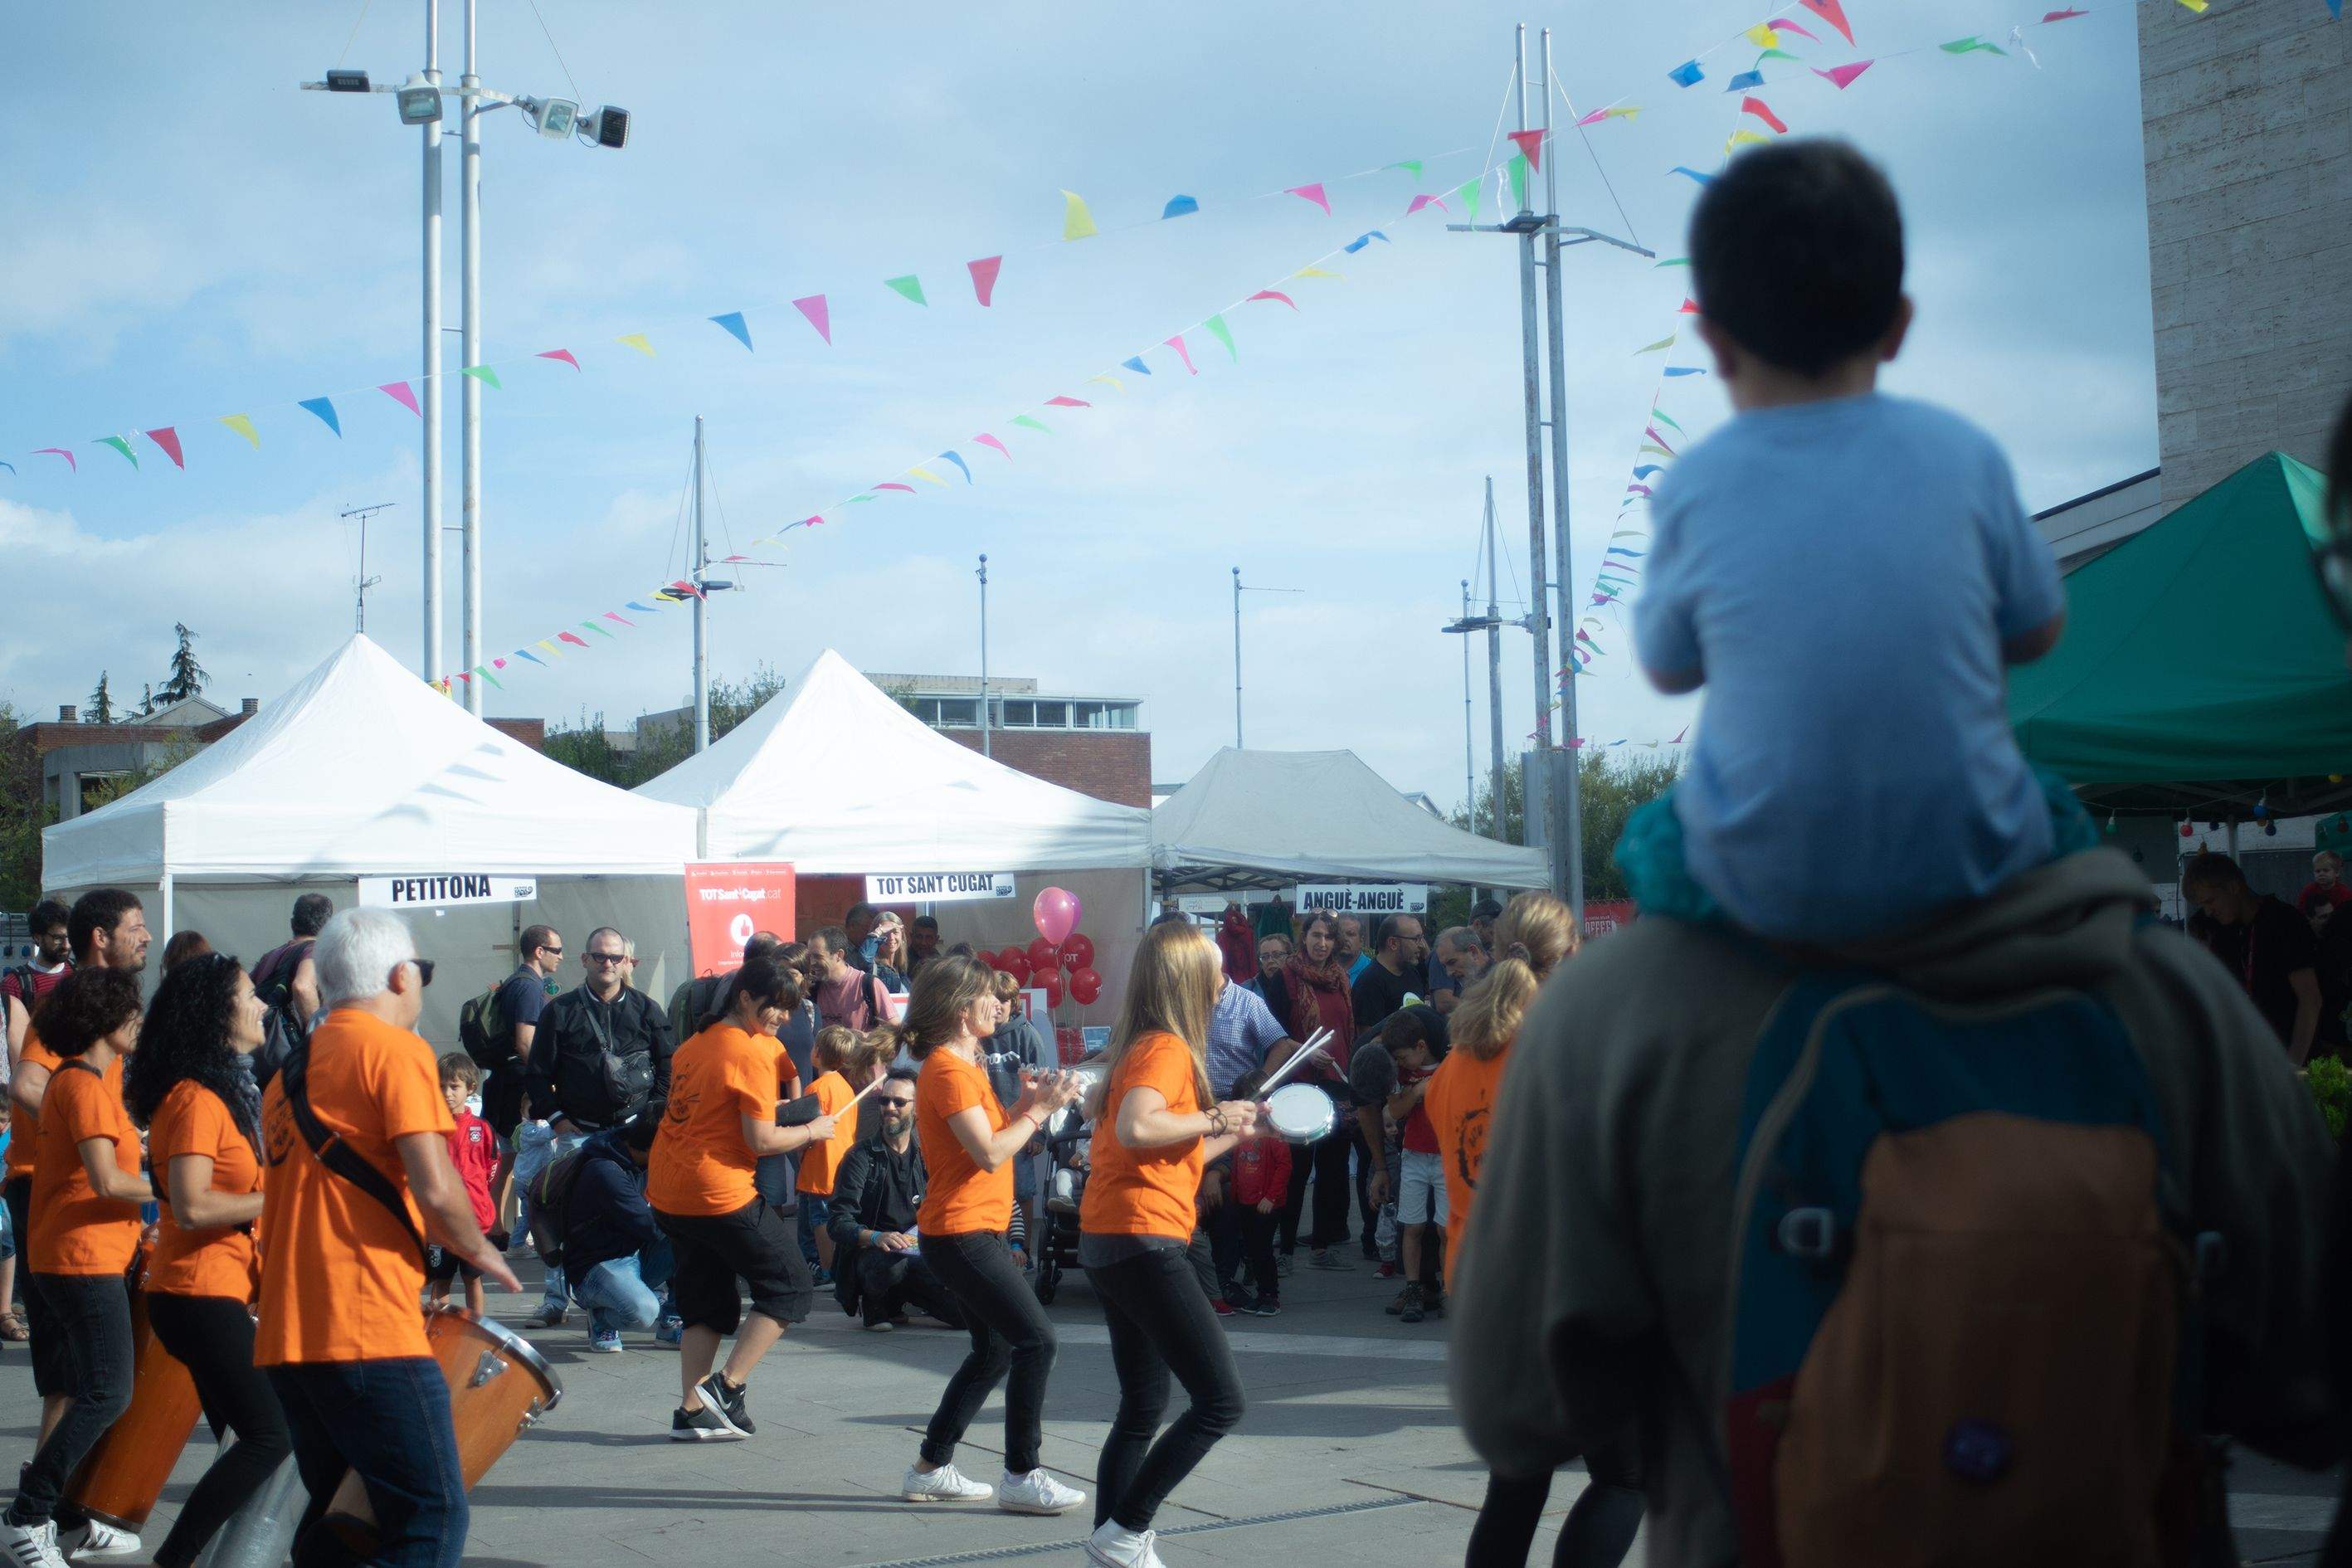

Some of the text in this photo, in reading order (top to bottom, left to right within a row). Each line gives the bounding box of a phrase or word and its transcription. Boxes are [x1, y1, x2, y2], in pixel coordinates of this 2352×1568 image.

[392, 875, 491, 902] PETITONA
[877, 878, 903, 894] TOT
[908, 875, 943, 894] SANT
[948, 874, 994, 892] CUGAT
[1303, 889, 1404, 910] ANGUÈ-ANGUÈ
[1585, 920, 1611, 935] OFFEE
[1064, 953, 1079, 962] OT
